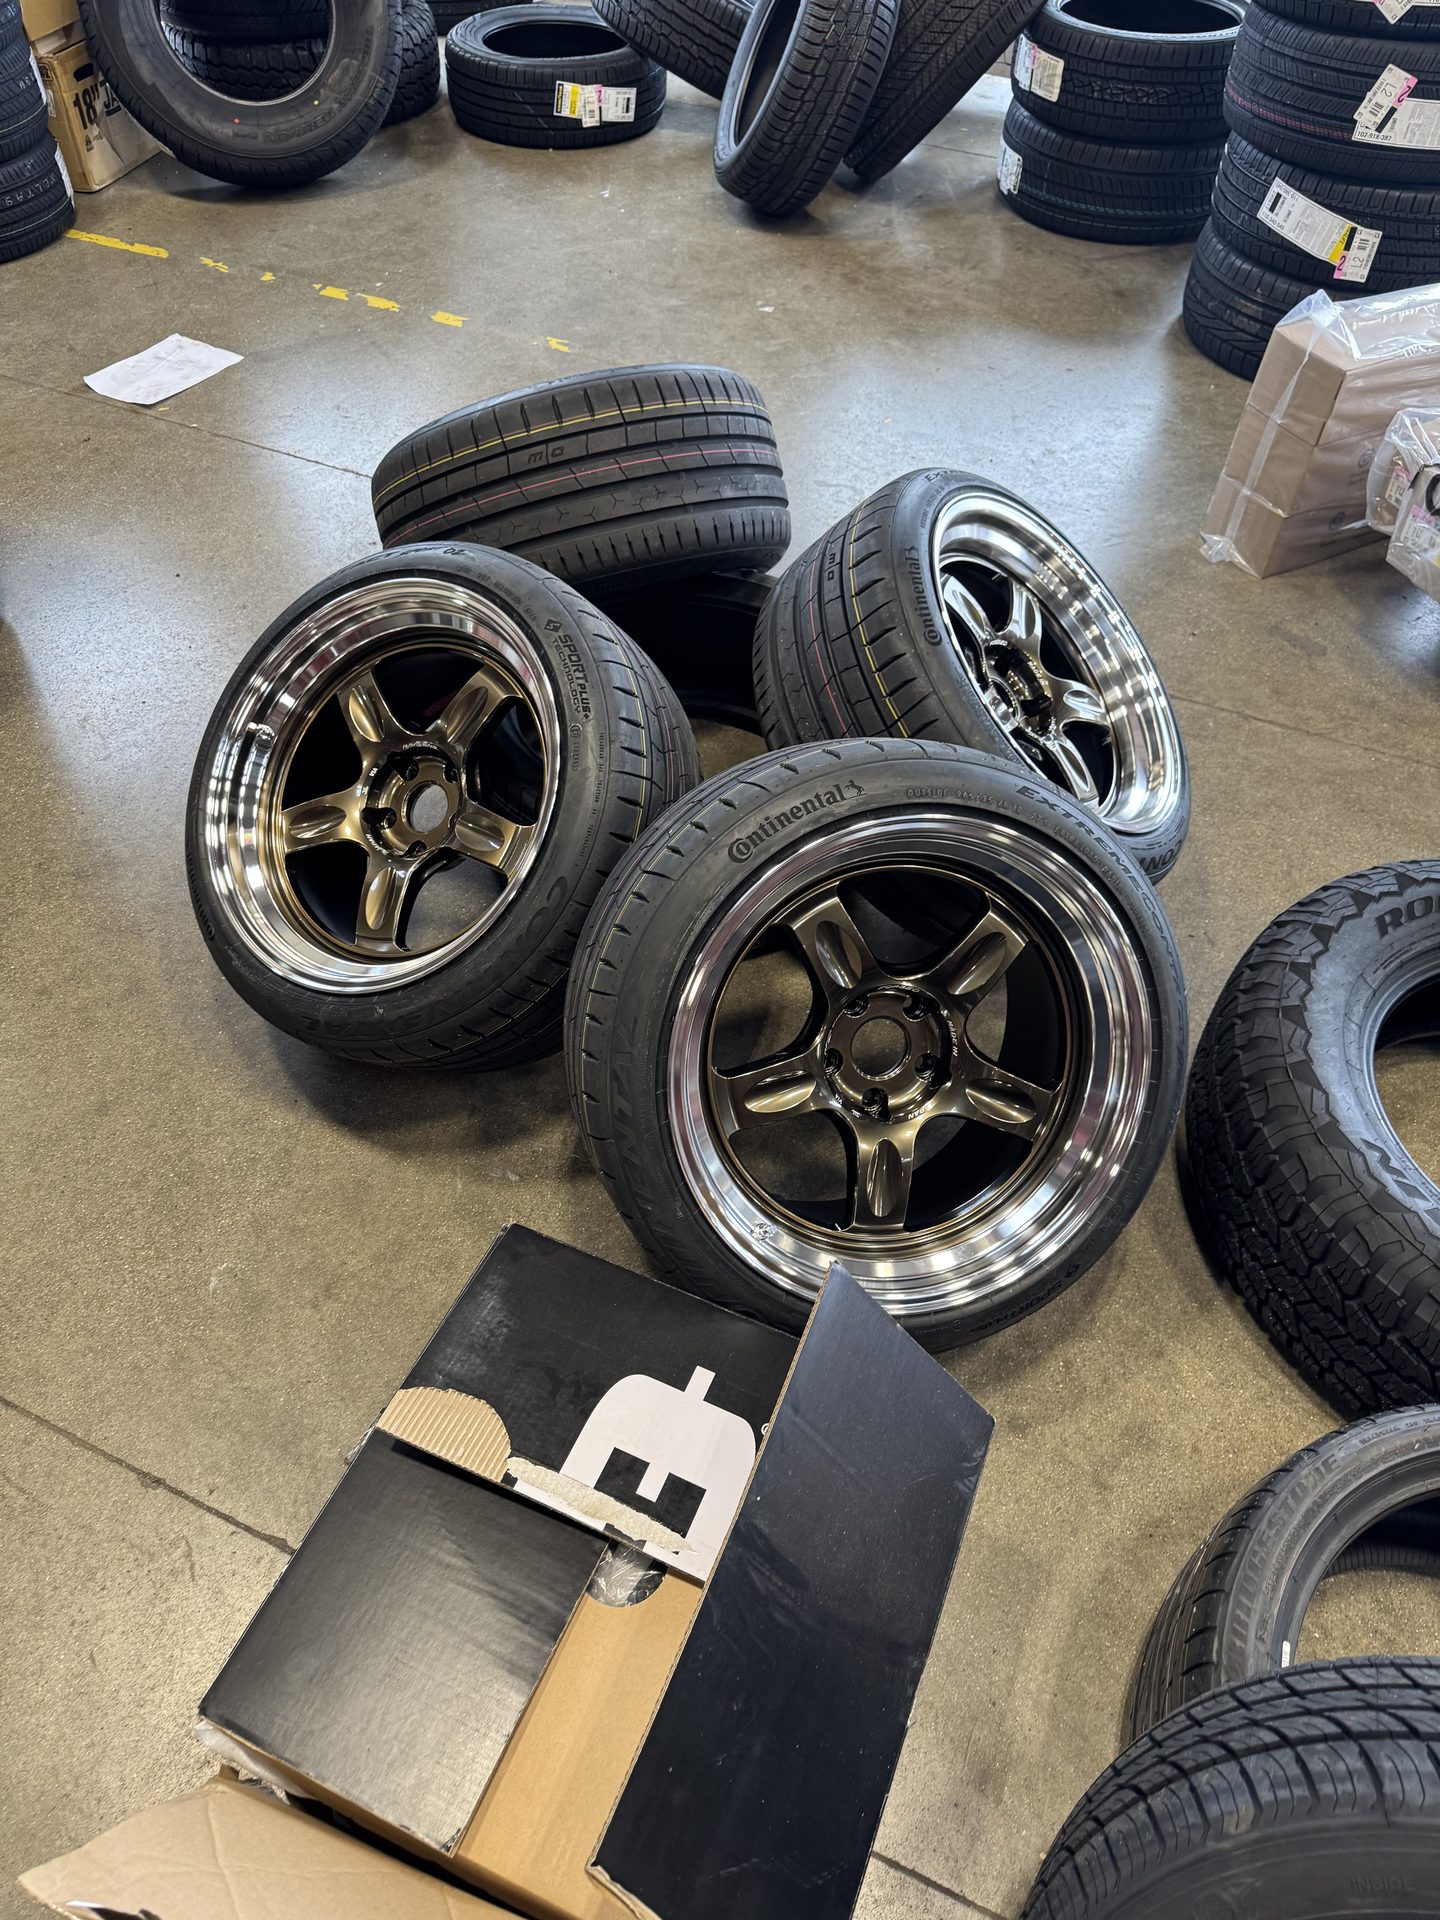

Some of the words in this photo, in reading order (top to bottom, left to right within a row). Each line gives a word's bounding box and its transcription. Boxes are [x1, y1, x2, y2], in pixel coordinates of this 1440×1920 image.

[1381, 82, 1397, 98] L2
[1397, 85, 1412, 103] 2
[1337, 255, 1347, 271] 2
[1350, 256, 1365, 268] L2
[905, 556, 943, 647] Continental
[552, 637, 581, 713] TECHNOLOGY
[906, 789, 949, 798] OUTSIDE
[727, 783, 847, 864] Continental
[1375, 895, 1440, 939] RO
[948, 1020, 957, 1044] MADE
[953, 1045, 958, 1057] IN
